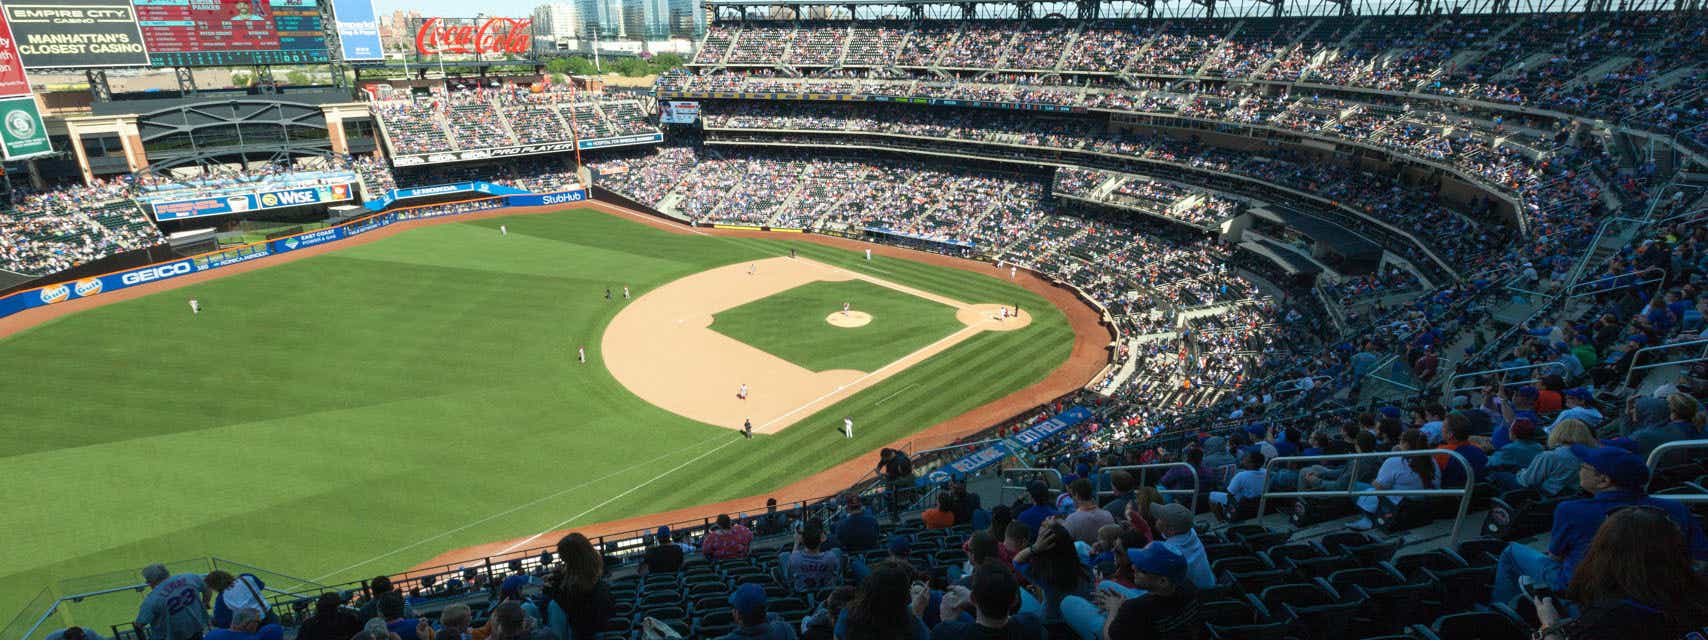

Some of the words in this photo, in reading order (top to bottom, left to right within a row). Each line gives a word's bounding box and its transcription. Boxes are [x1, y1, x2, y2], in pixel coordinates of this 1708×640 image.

[14, 9, 84, 18] EMPIRE
[87, 9, 124, 18] CITY
[27, 33, 130, 44] MANHATTAN'S
[20, 43, 86, 55] CLOSEST
[89, 43, 143, 54] CASINO
[492, 148, 520, 156] PRO
[521, 143, 572, 153] PLAYER
[420, 185, 457, 195] HONDA
[278, 190, 313, 204] WISE
[543, 192, 581, 205] StubHub
[300, 232, 316, 241] EAST
[316, 229, 335, 238] COAST
[122, 261, 190, 285] GEICO
[78, 279, 103, 294] Gulf
[42, 285, 69, 302] Gulf
